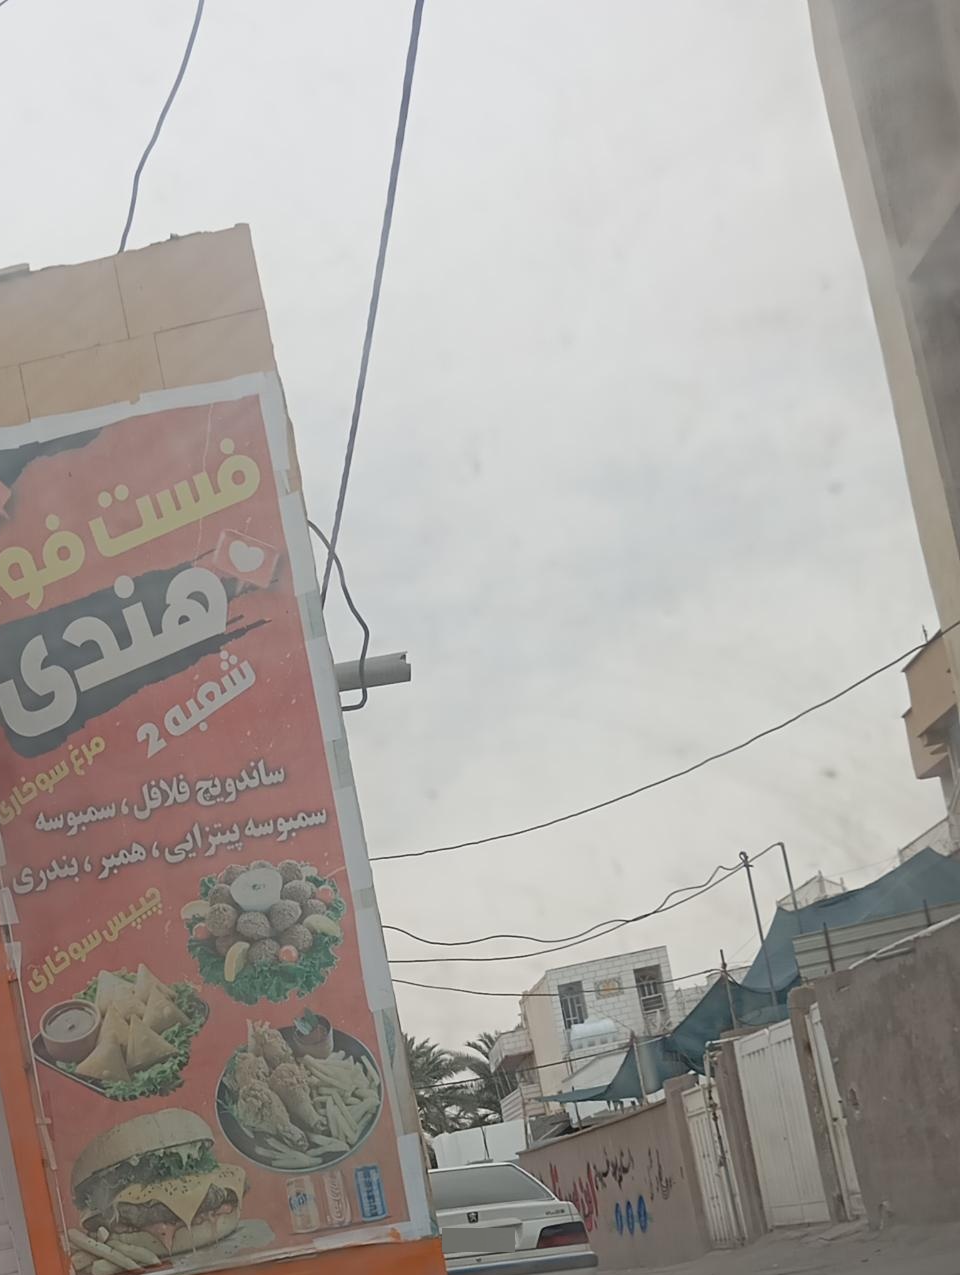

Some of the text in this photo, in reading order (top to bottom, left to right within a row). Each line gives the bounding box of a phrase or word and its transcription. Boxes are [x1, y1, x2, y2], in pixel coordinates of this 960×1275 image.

[87, 437, 261, 558] فست
[136, 649, 257, 759] شعبه 2
[69, 735, 106, 776] مرغ
[194, 758, 286, 806] ساندویچ
[34, 801, 117, 837] سمبوسه
[244, 807, 328, 842] سمبوسه
[12, 854, 80, 895] بندری
[27, 886, 163, 994] چیپس سوخاری
